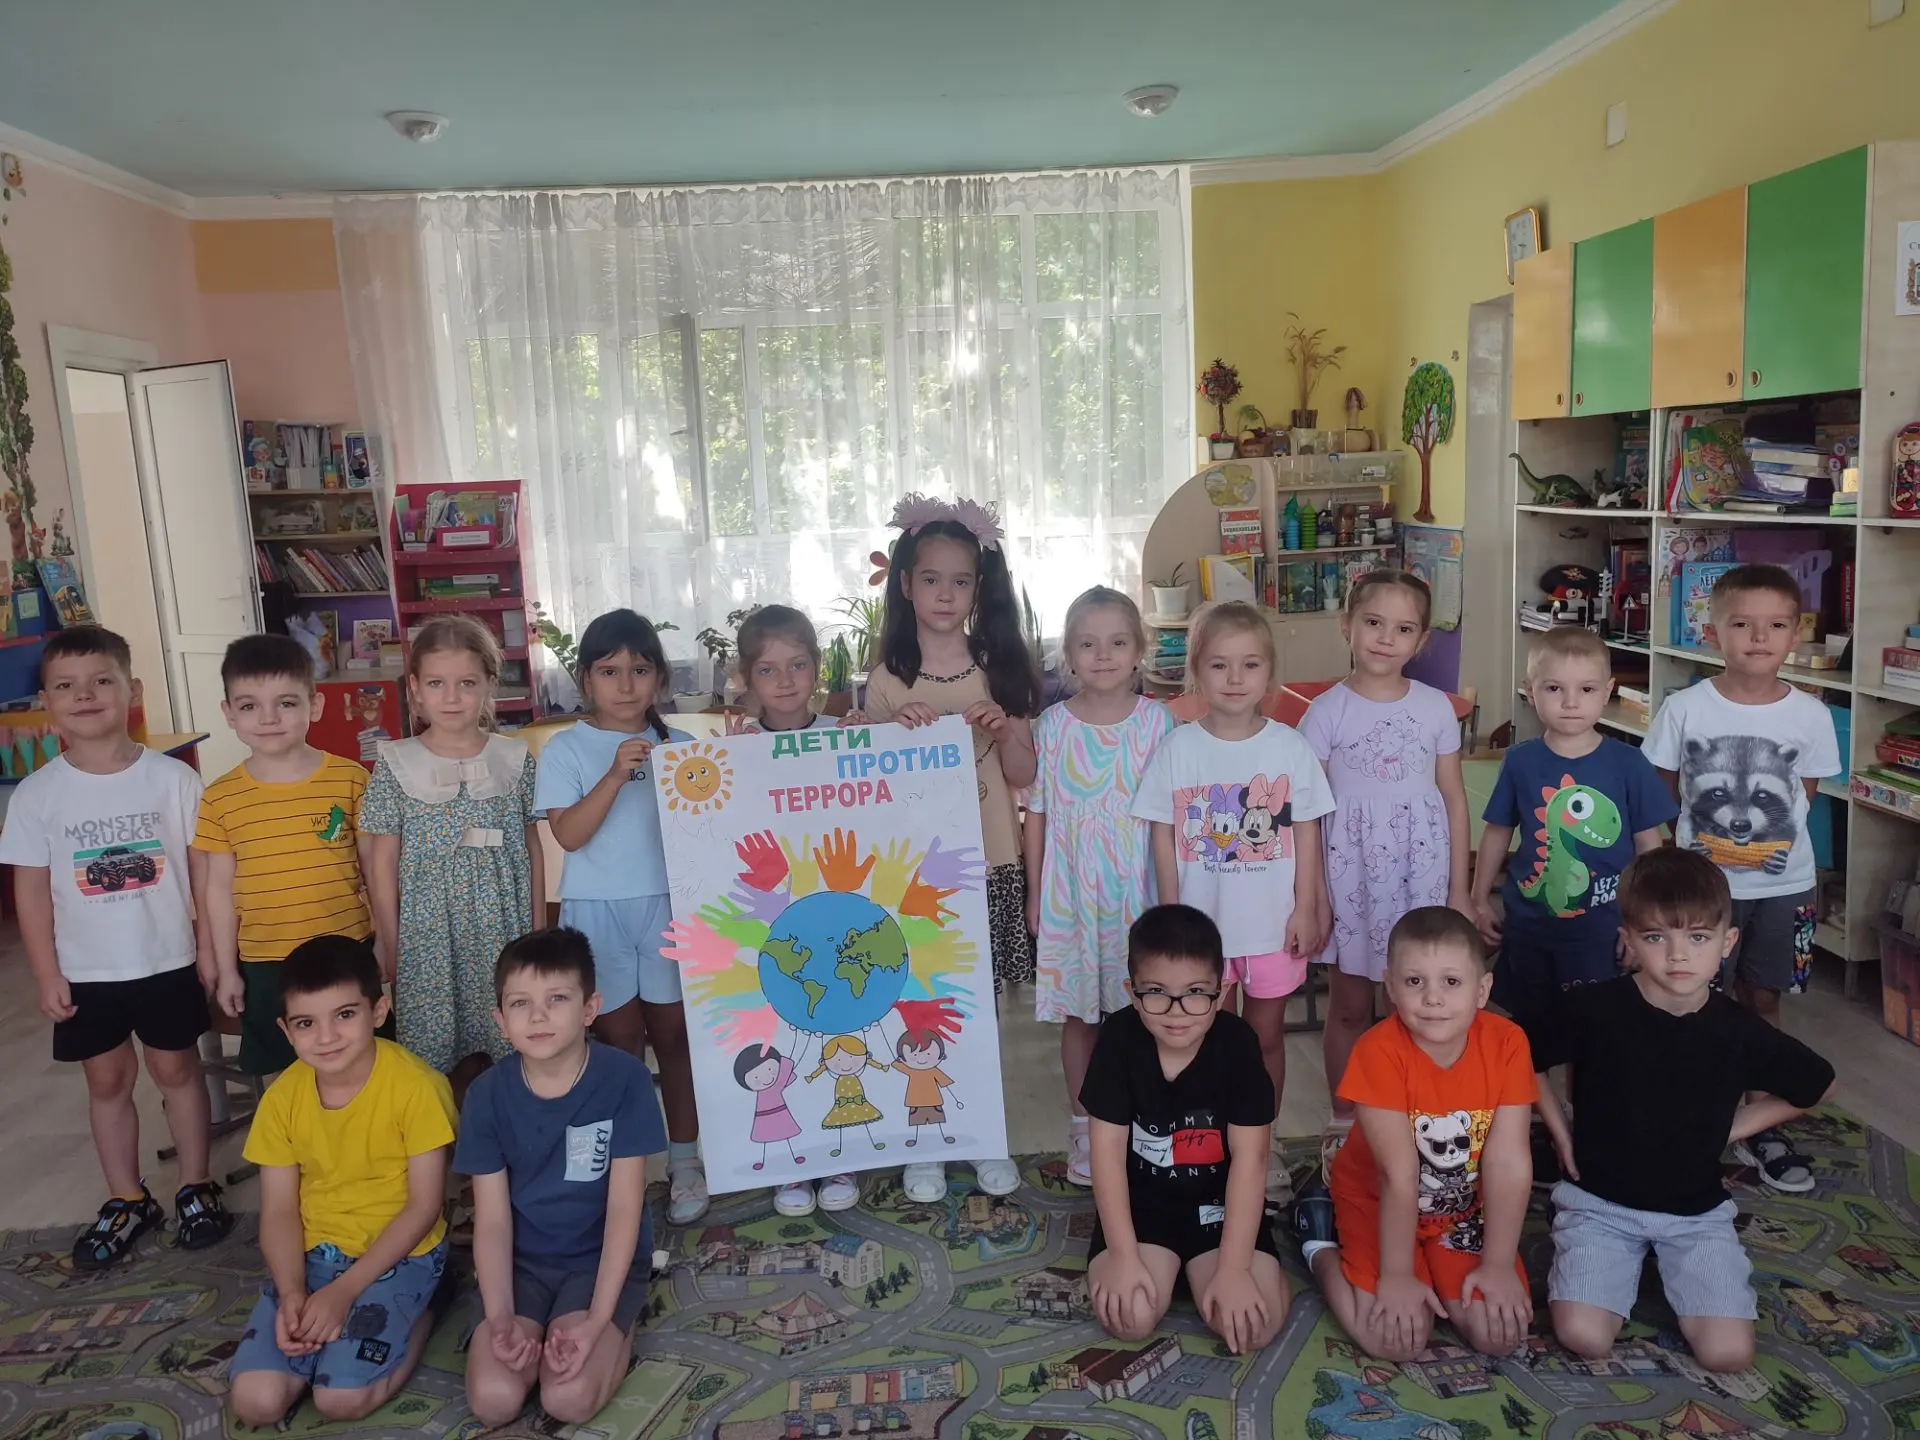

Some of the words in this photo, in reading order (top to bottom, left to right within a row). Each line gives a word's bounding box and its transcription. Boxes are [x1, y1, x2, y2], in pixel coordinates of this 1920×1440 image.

[772, 728, 872, 759] ДЕТИ
[837, 743, 961, 779] ПРОТИВ
[768, 779, 893, 814] ТЕРРОРА
[64, 812, 162, 839] MONSTER
[75, 826, 154, 848] TRUCKS
[1594, 874, 1621, 895] LET'S
[1590, 892, 1617, 907] ROA
[1139, 1160, 1217, 1178] JEANS
